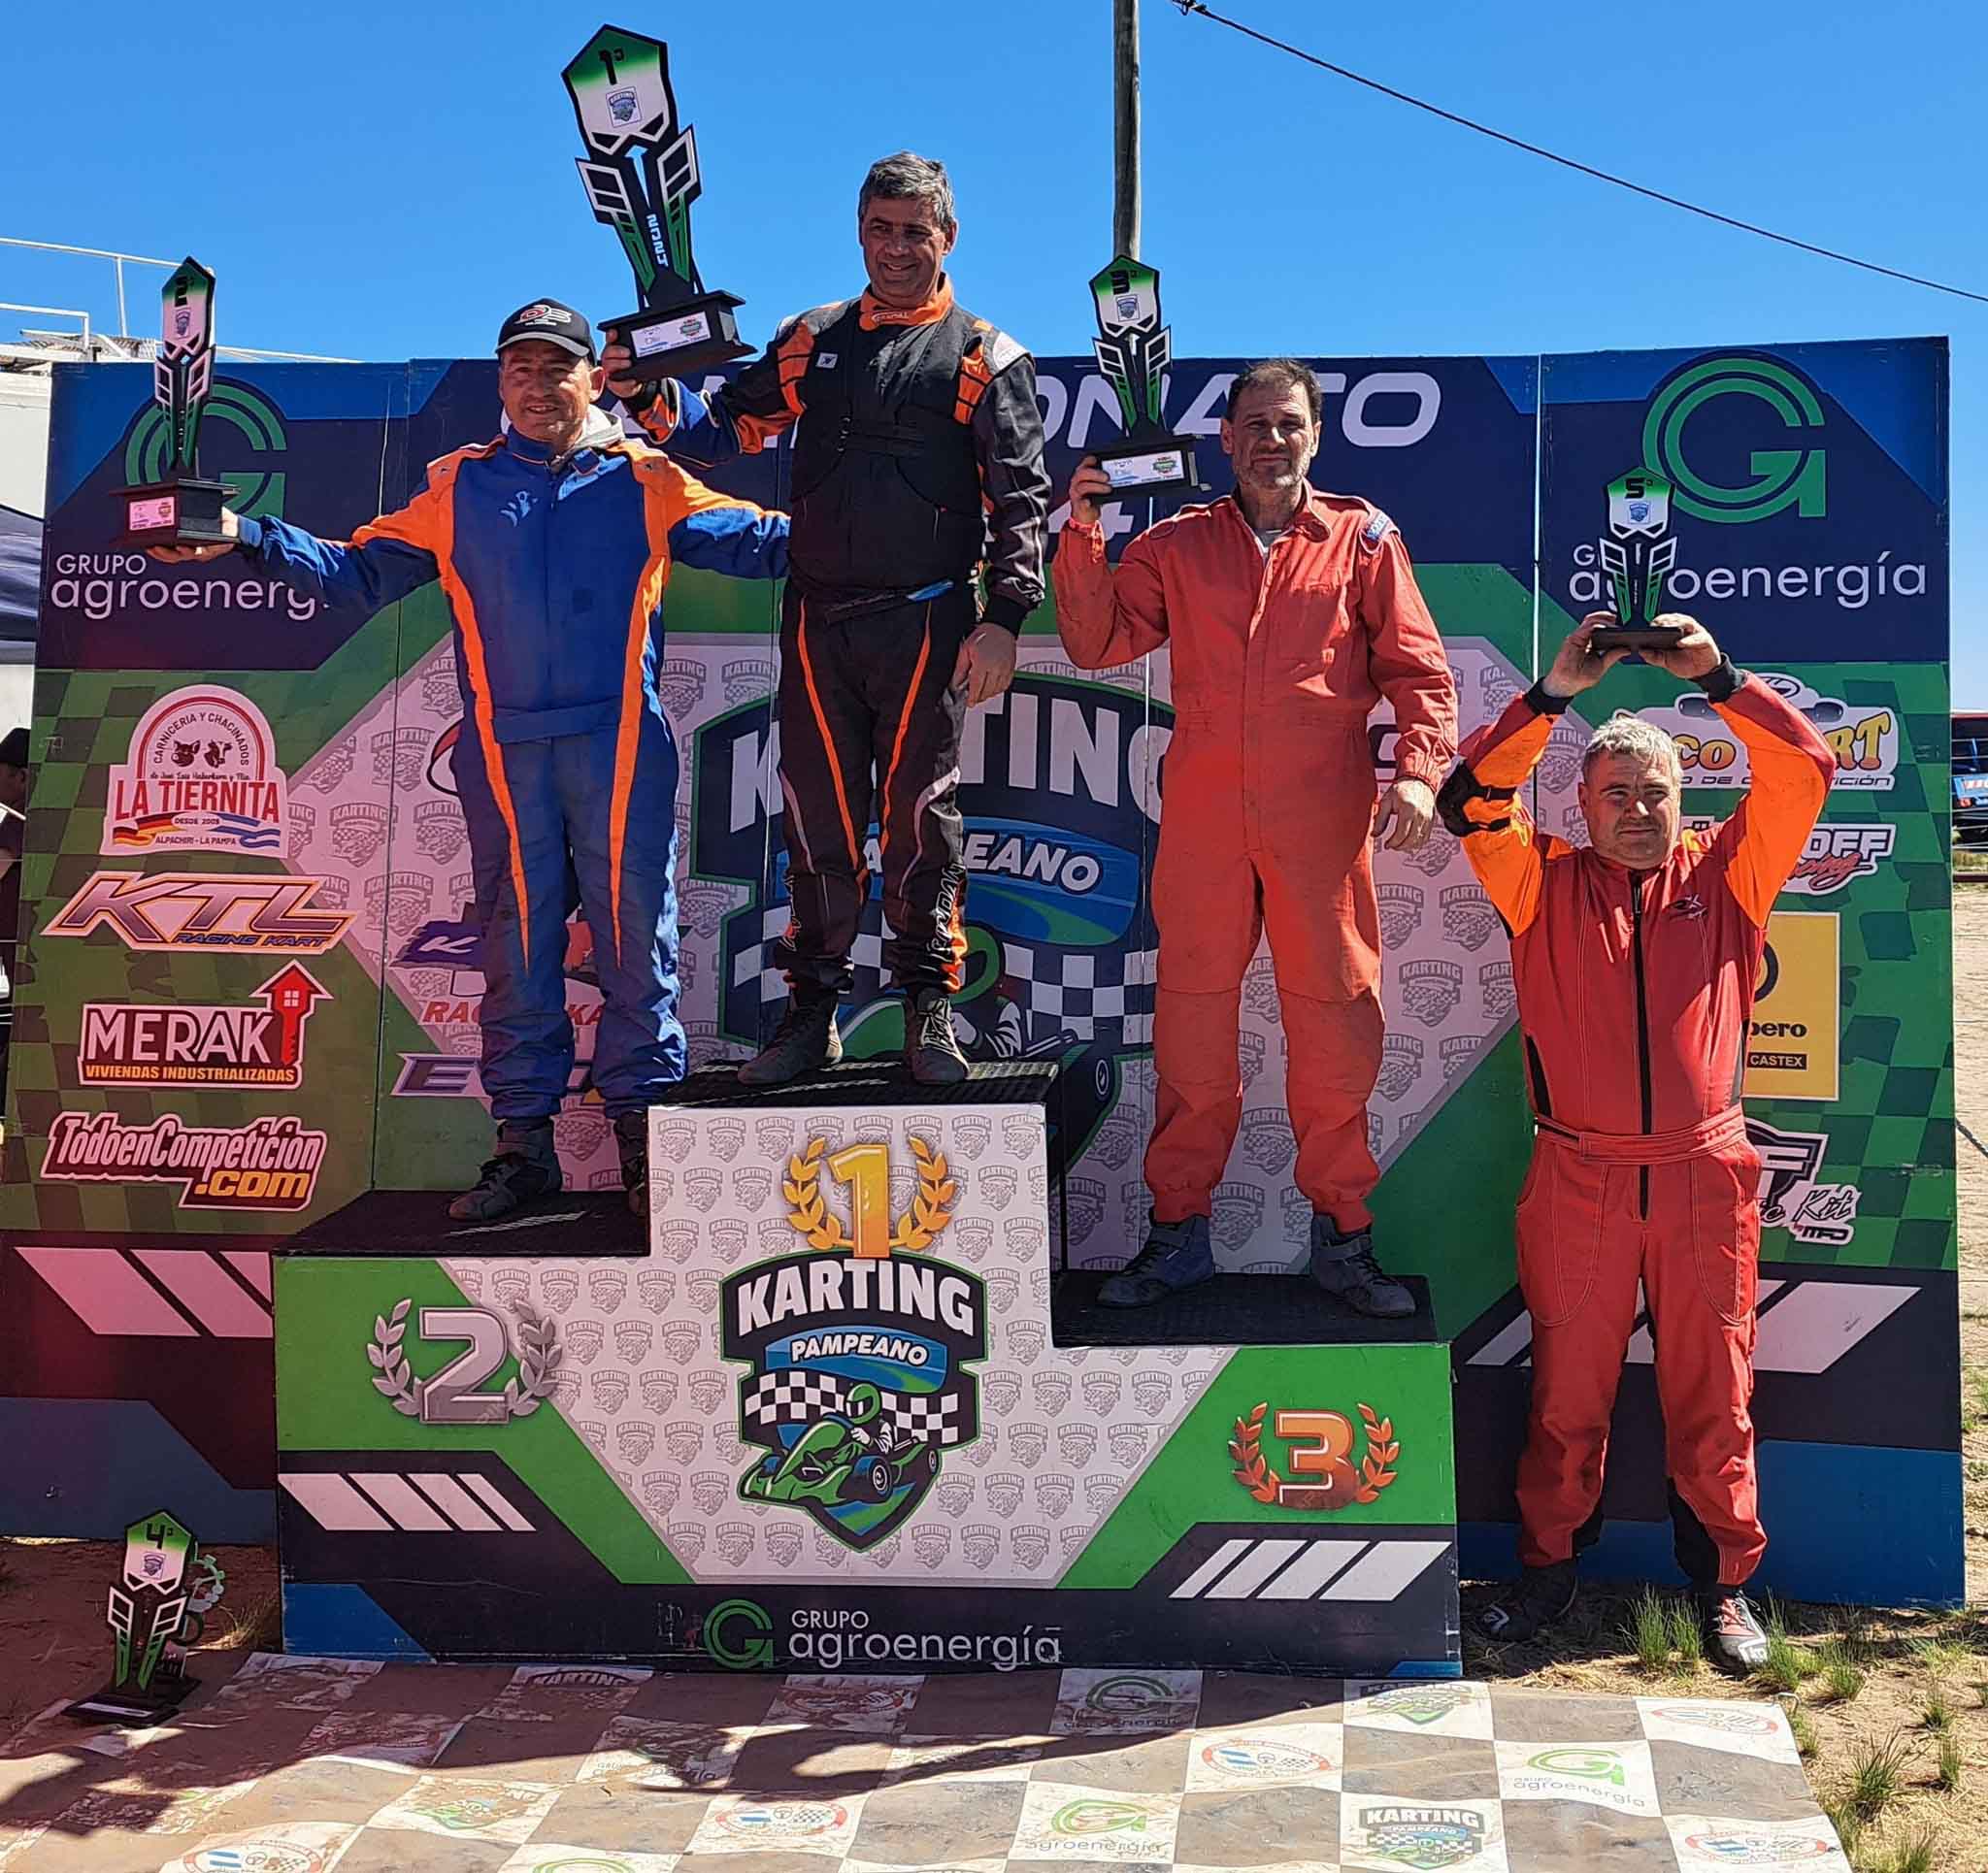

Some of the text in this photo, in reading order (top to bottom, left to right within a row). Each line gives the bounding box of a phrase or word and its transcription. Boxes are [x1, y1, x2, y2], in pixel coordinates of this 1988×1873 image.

[55, 553, 147, 575] GRUPO
[1568, 551, 1927, 608] aoenergía
[115, 779, 280, 823] LA TIERNITA
[55, 877, 350, 943] KTL
[86, 1010, 275, 1064] MERAK
[85, 1065, 294, 1083] VIVIENDAS INDUSTRIALIZADAS
[1750, 1055, 1803, 1068] CASTEX
[195, 1170, 310, 1198] .com
[828, 1143, 890, 1259] 1
[737, 1258, 975, 1337] KARTING
[419, 1307, 510, 1425] 2
[790, 1333, 930, 1367] PAMPEANO
[1275, 1410, 1359, 1511] 3
[792, 1610, 870, 1629] GRUPO
[788, 1625, 1062, 1672] agroenergía
[1367, 1808, 1479, 1828] KARTING
